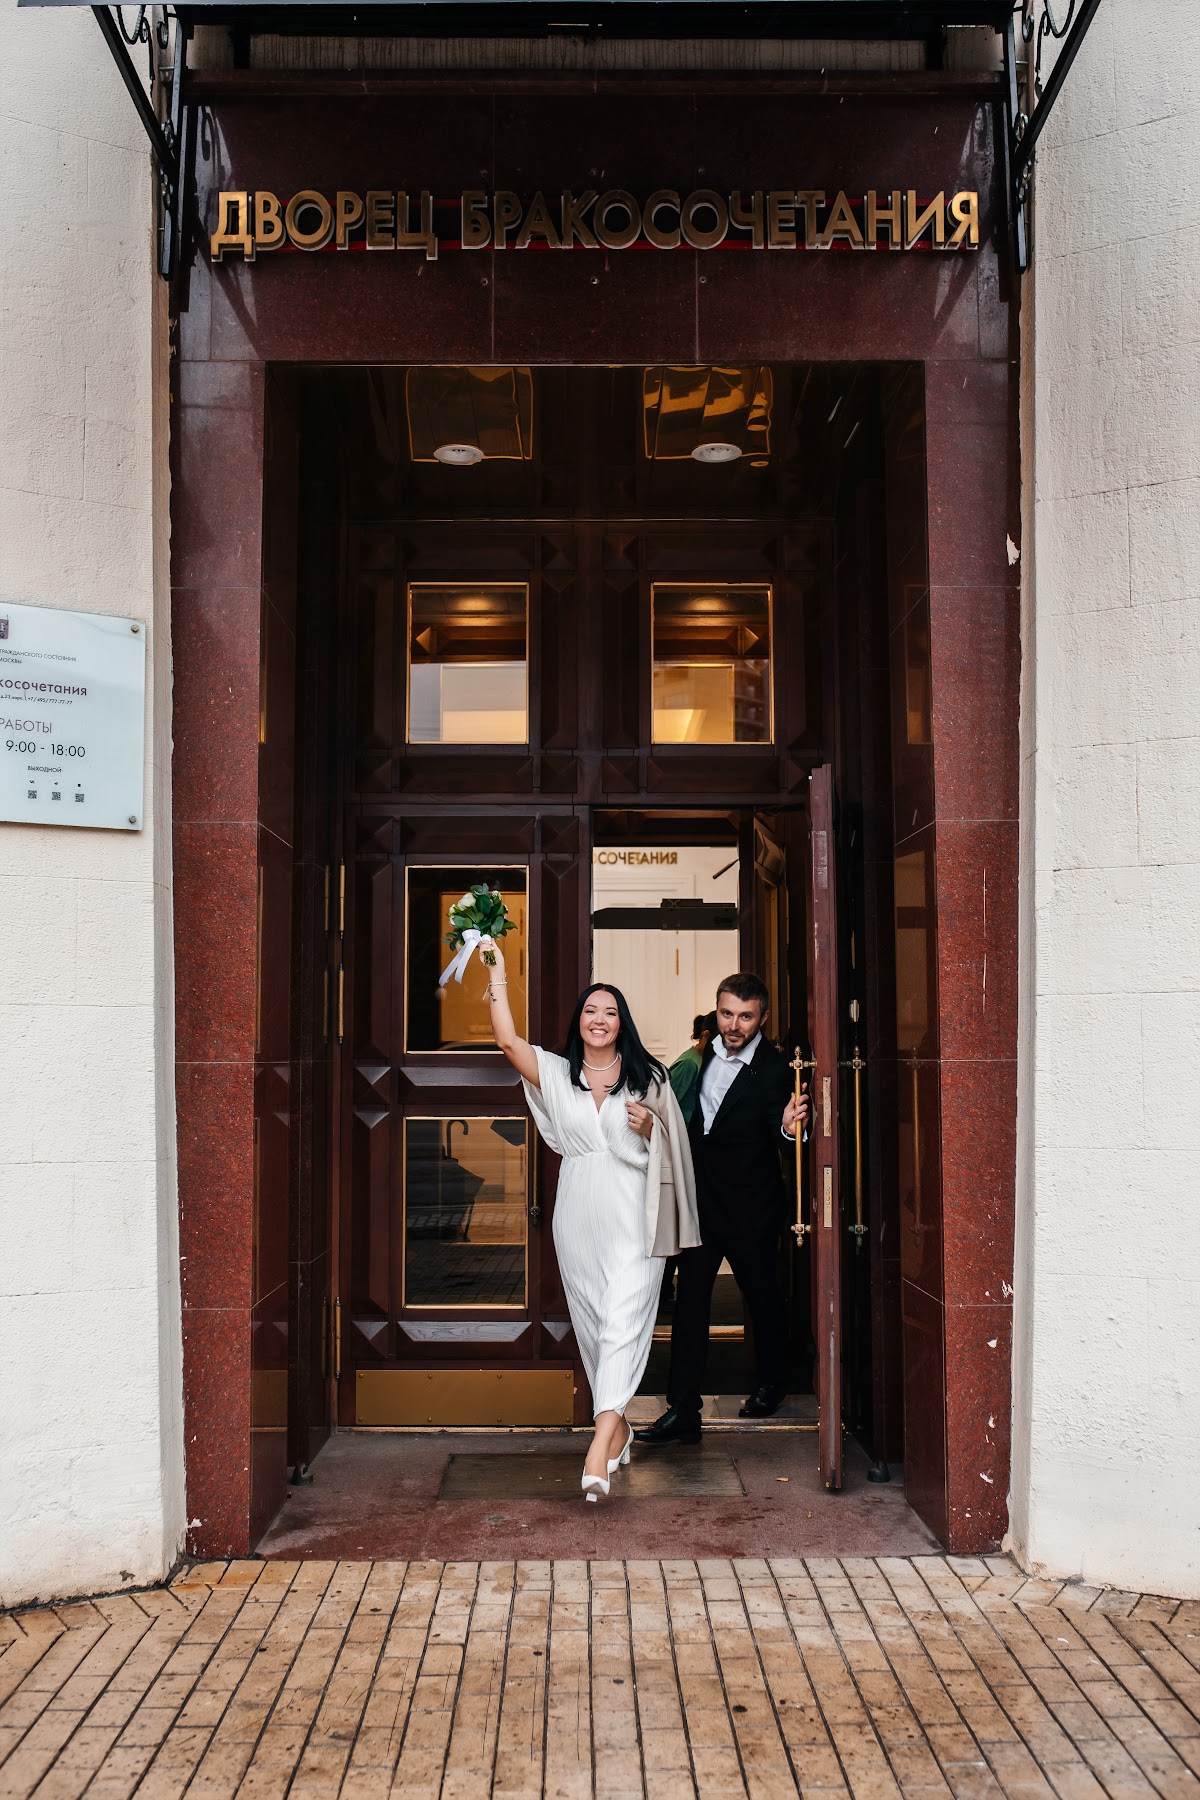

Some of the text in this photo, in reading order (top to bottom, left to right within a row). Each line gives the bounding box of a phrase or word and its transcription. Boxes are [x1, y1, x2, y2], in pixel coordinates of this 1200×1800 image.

[210, 189, 980, 262] ДВОРЕЦ БРАКОСОЧЕТАНИЯ
[6, 739, 36, 753] 9:00
[51, 743, 86, 757] 18:00
